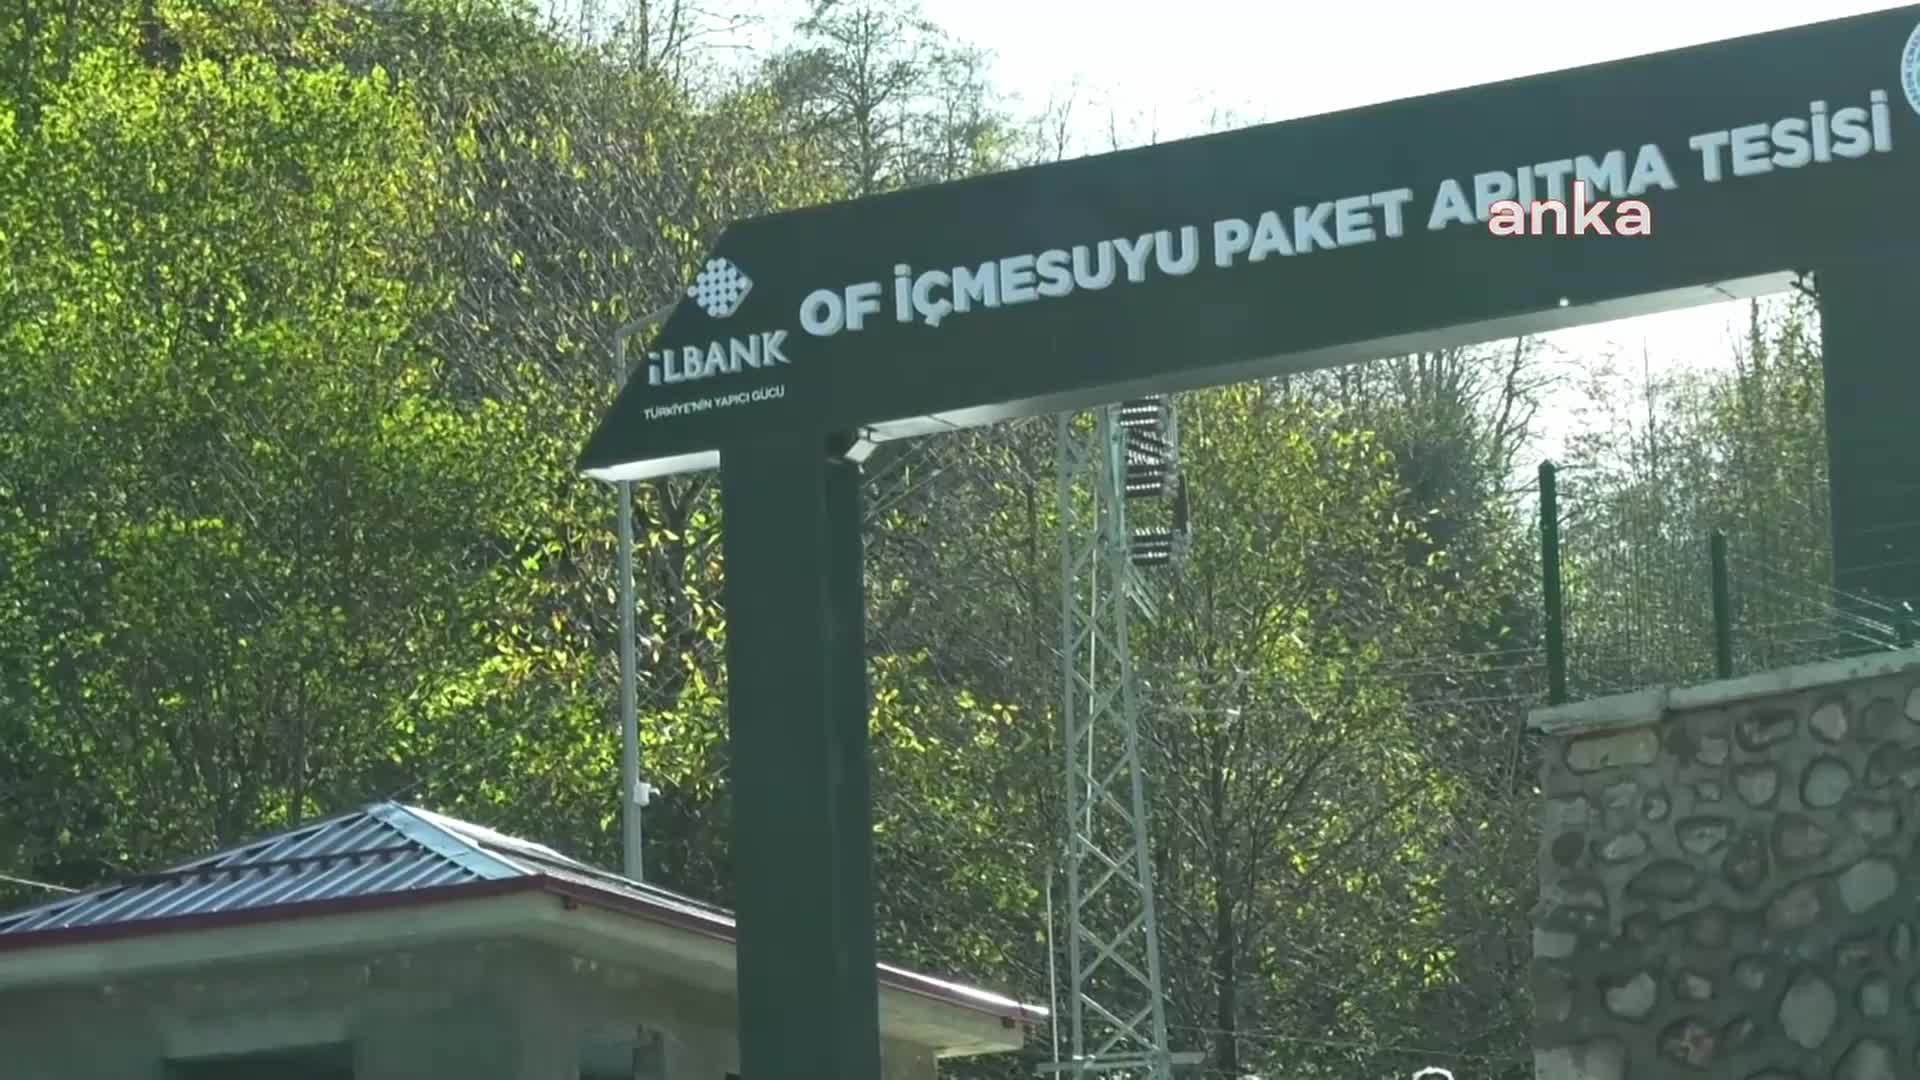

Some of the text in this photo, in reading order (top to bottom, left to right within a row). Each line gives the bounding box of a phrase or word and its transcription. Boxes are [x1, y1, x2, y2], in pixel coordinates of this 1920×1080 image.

[799, 281, 882, 337] OF
[893, 226, 1198, 328] İÇMESUYU
[1213, 188, 1413, 268] PAKET
[1689, 89, 1891, 182] TESİSİ
